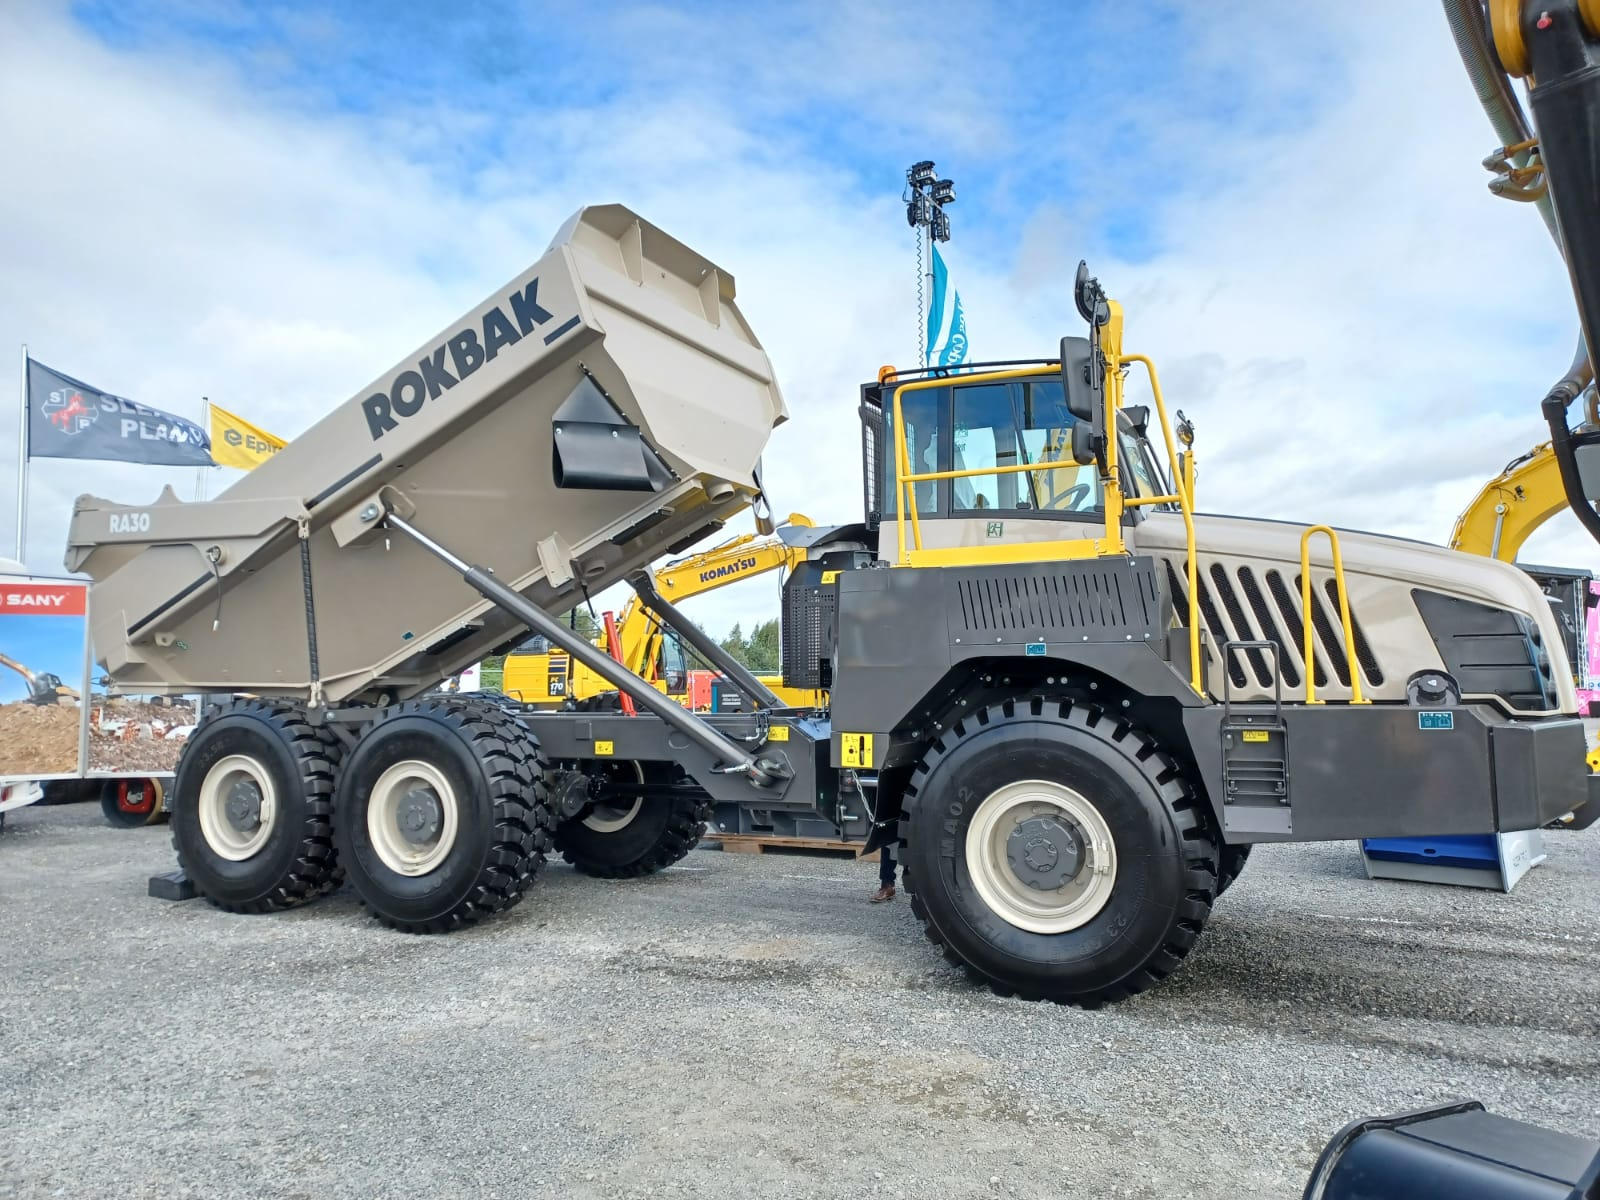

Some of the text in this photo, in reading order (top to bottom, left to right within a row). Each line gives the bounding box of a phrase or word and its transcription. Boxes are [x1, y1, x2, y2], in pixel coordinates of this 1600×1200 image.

[361, 276, 554, 441] ROKBAK
[110, 512, 150, 533] RA30
[700, 557, 756, 582] KOMATSU
[6, 593, 65, 606] SANY
